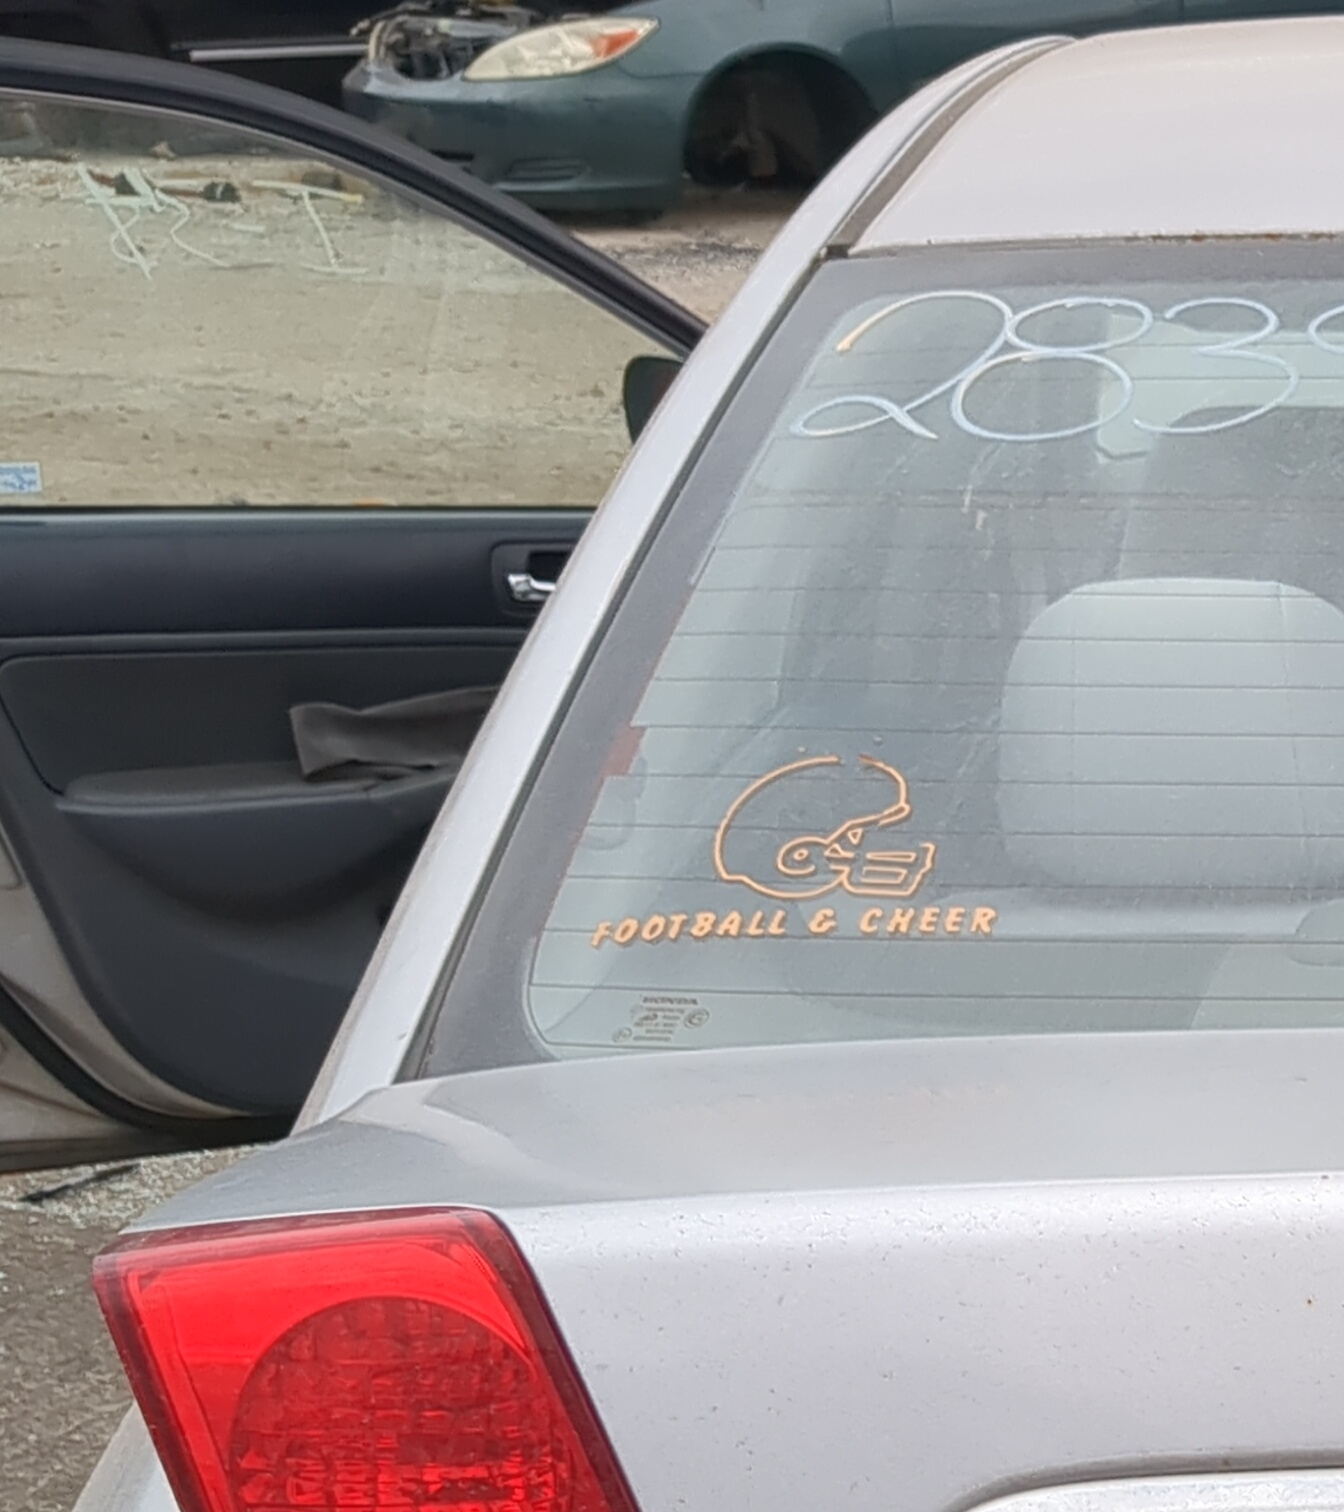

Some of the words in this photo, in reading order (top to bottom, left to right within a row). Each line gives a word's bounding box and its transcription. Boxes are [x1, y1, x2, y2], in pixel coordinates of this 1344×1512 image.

[590, 908, 787, 947] FOOTBALL
[808, 906, 838, 934] &
[858, 906, 997, 934] CHEER
